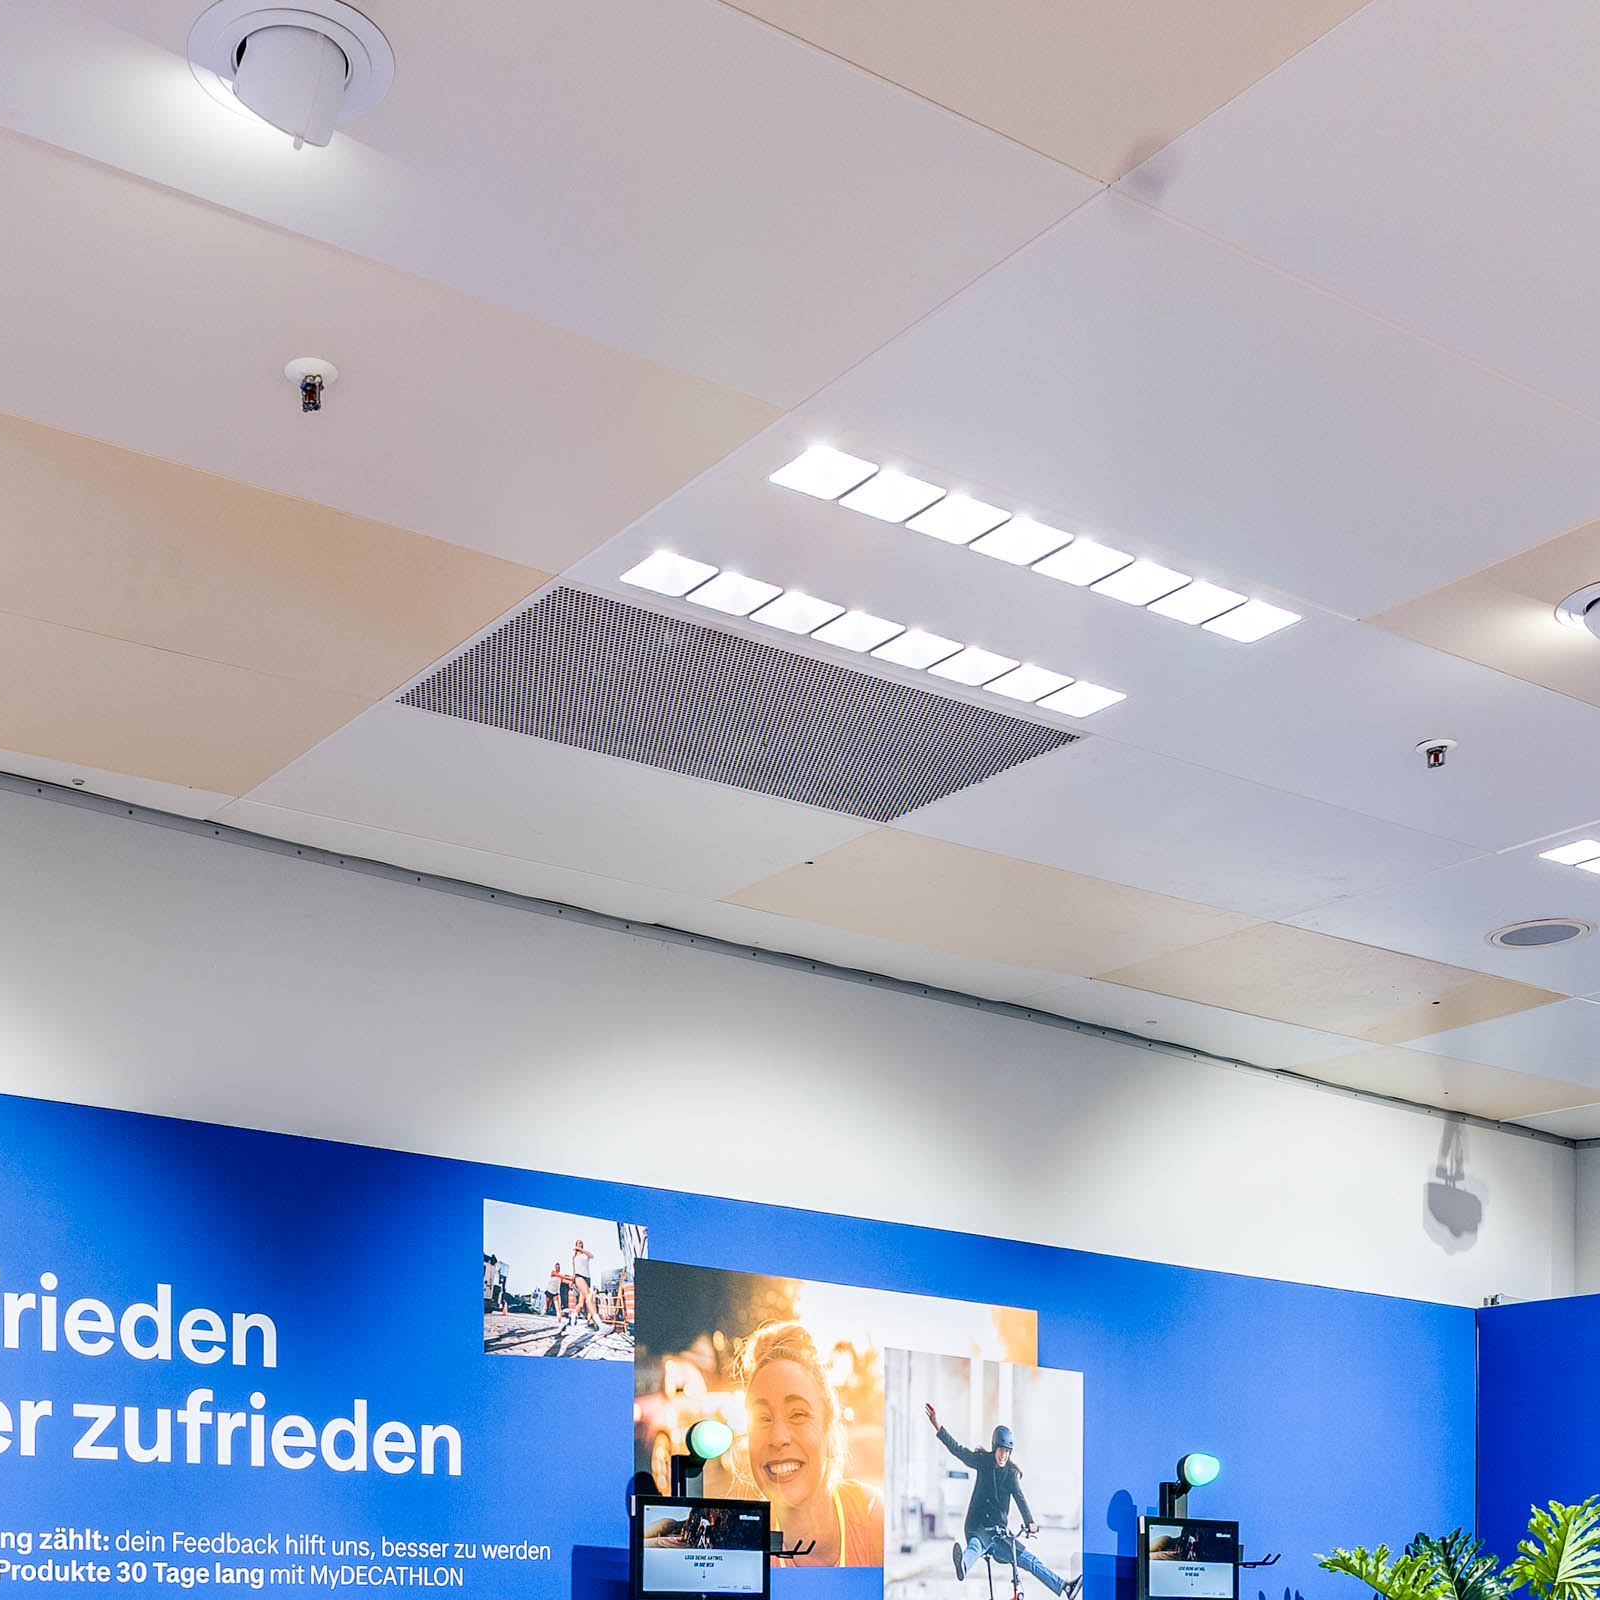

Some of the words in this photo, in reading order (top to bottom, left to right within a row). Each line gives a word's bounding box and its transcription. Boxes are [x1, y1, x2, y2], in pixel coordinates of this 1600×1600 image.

[73, 1388, 462, 1476] zufrieden
[39, 1527, 109, 1551] zählt:
[115, 1529, 165, 1552] dein
[172, 1531, 279, 1555] Feedback
[285, 1533, 326, 1556] hilft
[332, 1540, 375, 1561] uns,
[382, 1535, 450, 1558] besser
[454, 1543, 476, 1559] zu
[481, 1540, 551, 1561] werden
[116, 1561, 147, 1583] 30
[152, 1562, 210, 1589] Tage
[215, 1562, 264, 1589] lang
[270, 1565, 305, 1585] mit
[310, 1564, 463, 1590] MyDECATHLON
